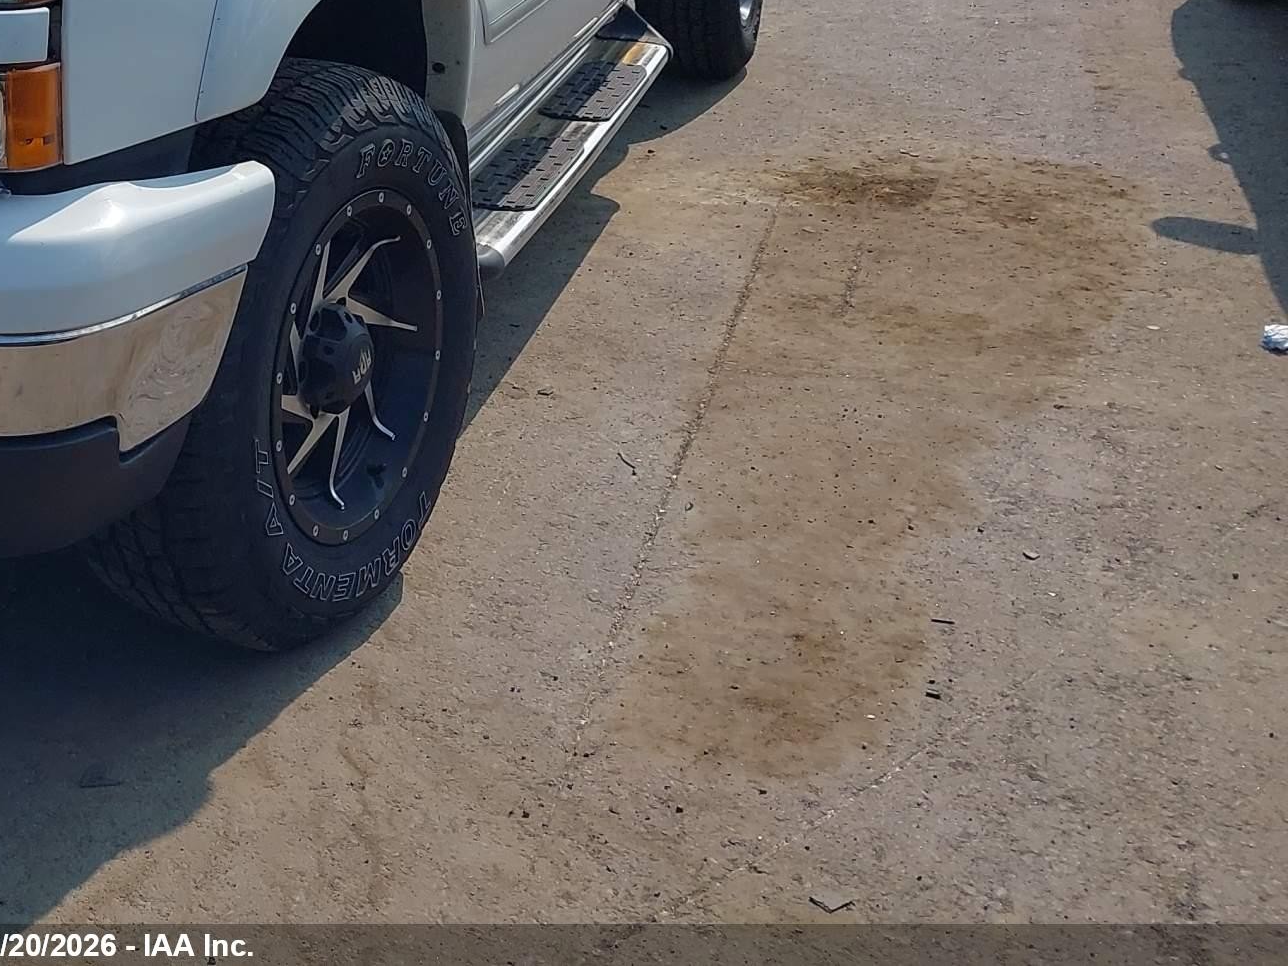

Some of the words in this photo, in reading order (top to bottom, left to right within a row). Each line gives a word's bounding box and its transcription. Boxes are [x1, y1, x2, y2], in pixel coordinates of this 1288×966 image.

[355, 138, 467, 236] FORTUNE
[255, 439, 284, 536] A/T
[282, 491, 432, 602] TORMENTA
